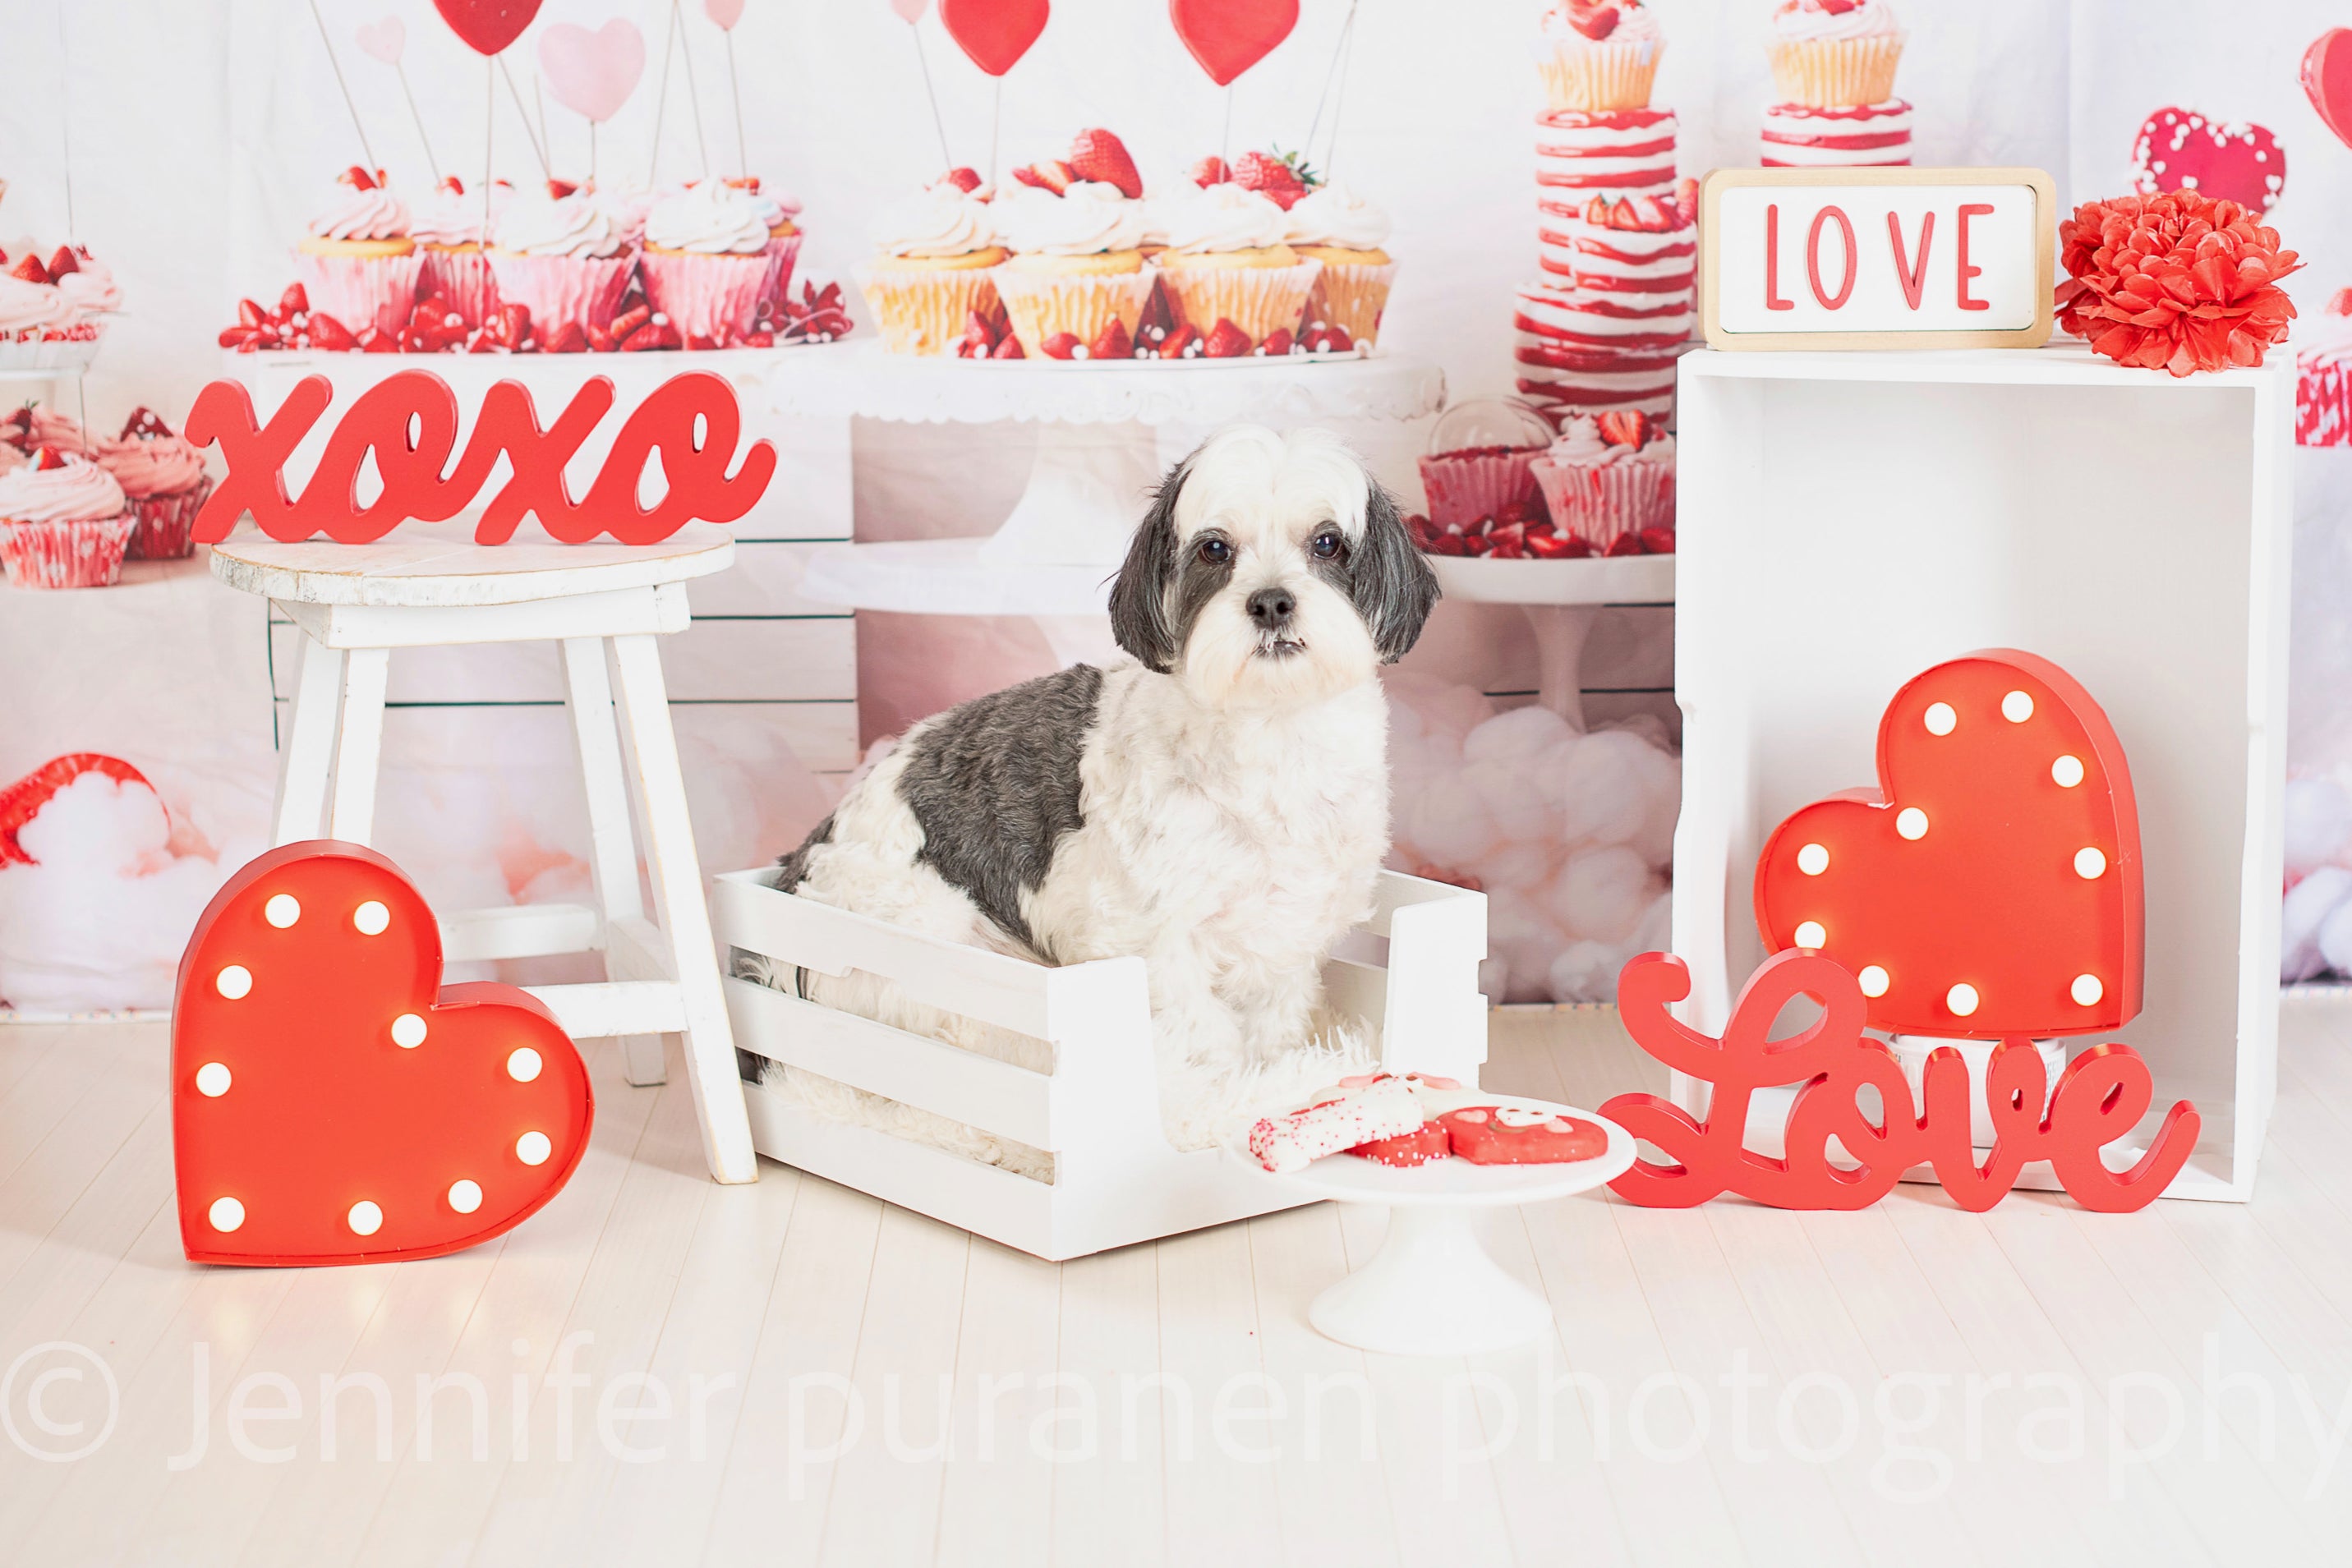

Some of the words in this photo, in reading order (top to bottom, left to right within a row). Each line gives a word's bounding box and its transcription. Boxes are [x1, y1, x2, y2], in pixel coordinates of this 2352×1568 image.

[1765, 203, 1995, 311] LOVE
[185, 369, 779, 546] xoxo
[1597, 947, 2202, 1214] Love
